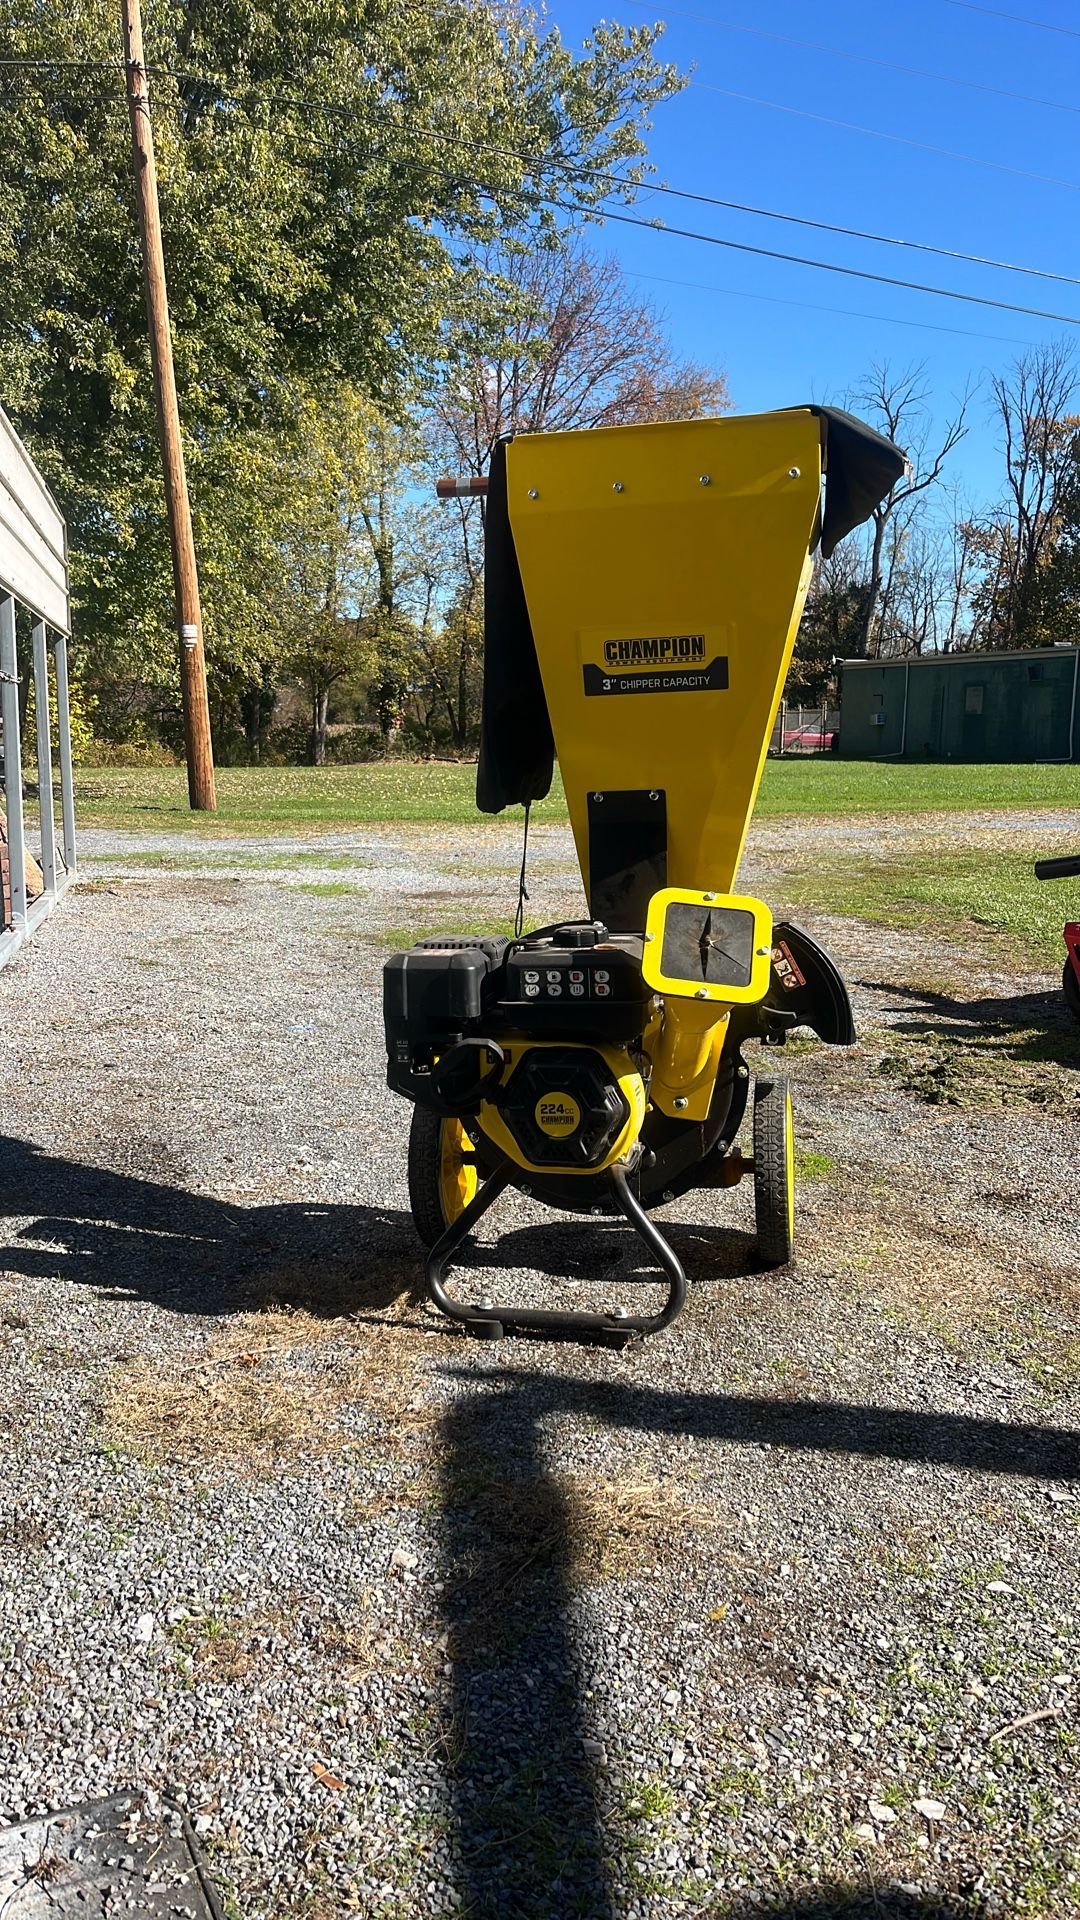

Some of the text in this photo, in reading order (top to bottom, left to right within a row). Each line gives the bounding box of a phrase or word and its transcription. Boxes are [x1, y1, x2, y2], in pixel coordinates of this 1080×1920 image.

[605, 636, 704, 660] CHAMPION
[620, 678, 661, 690] CHIPPER
[662, 676, 711, 688] CAPACITY
